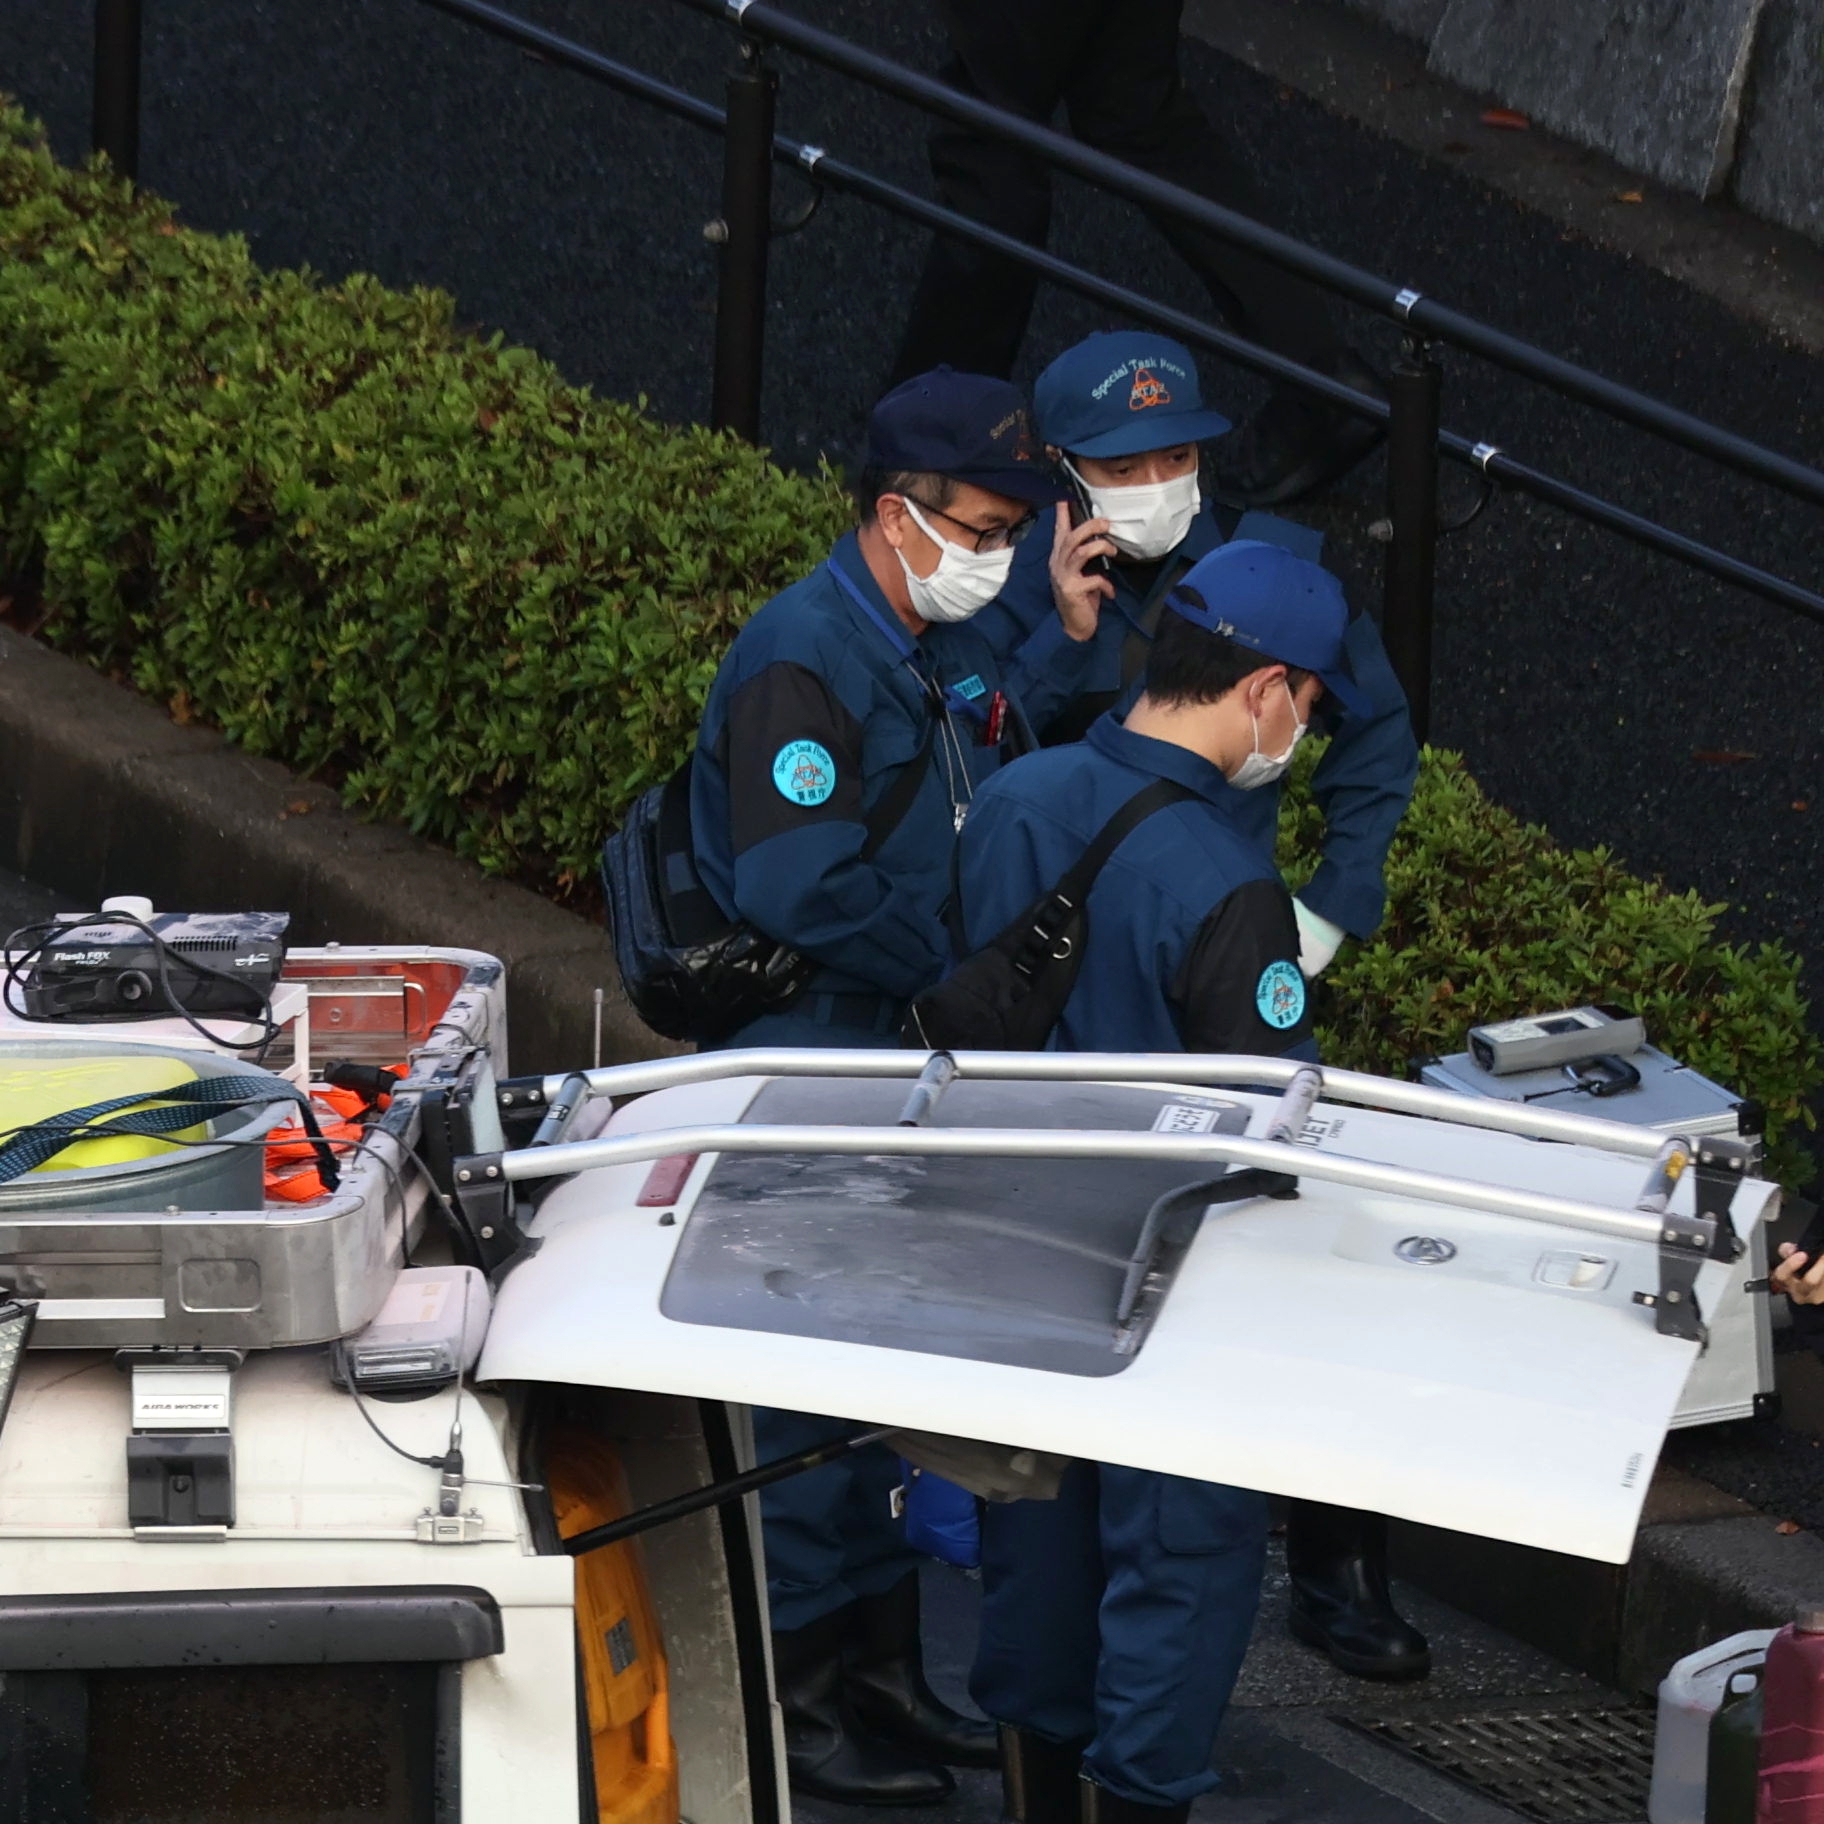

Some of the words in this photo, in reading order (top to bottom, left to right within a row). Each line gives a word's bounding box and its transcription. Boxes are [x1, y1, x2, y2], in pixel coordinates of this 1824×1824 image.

[1091, 363, 1129, 400] Special
[1128, 357, 1158, 370] Task
[1159, 357, 1186, 379] Force
[1293, 1115, 1331, 1149] IJET
